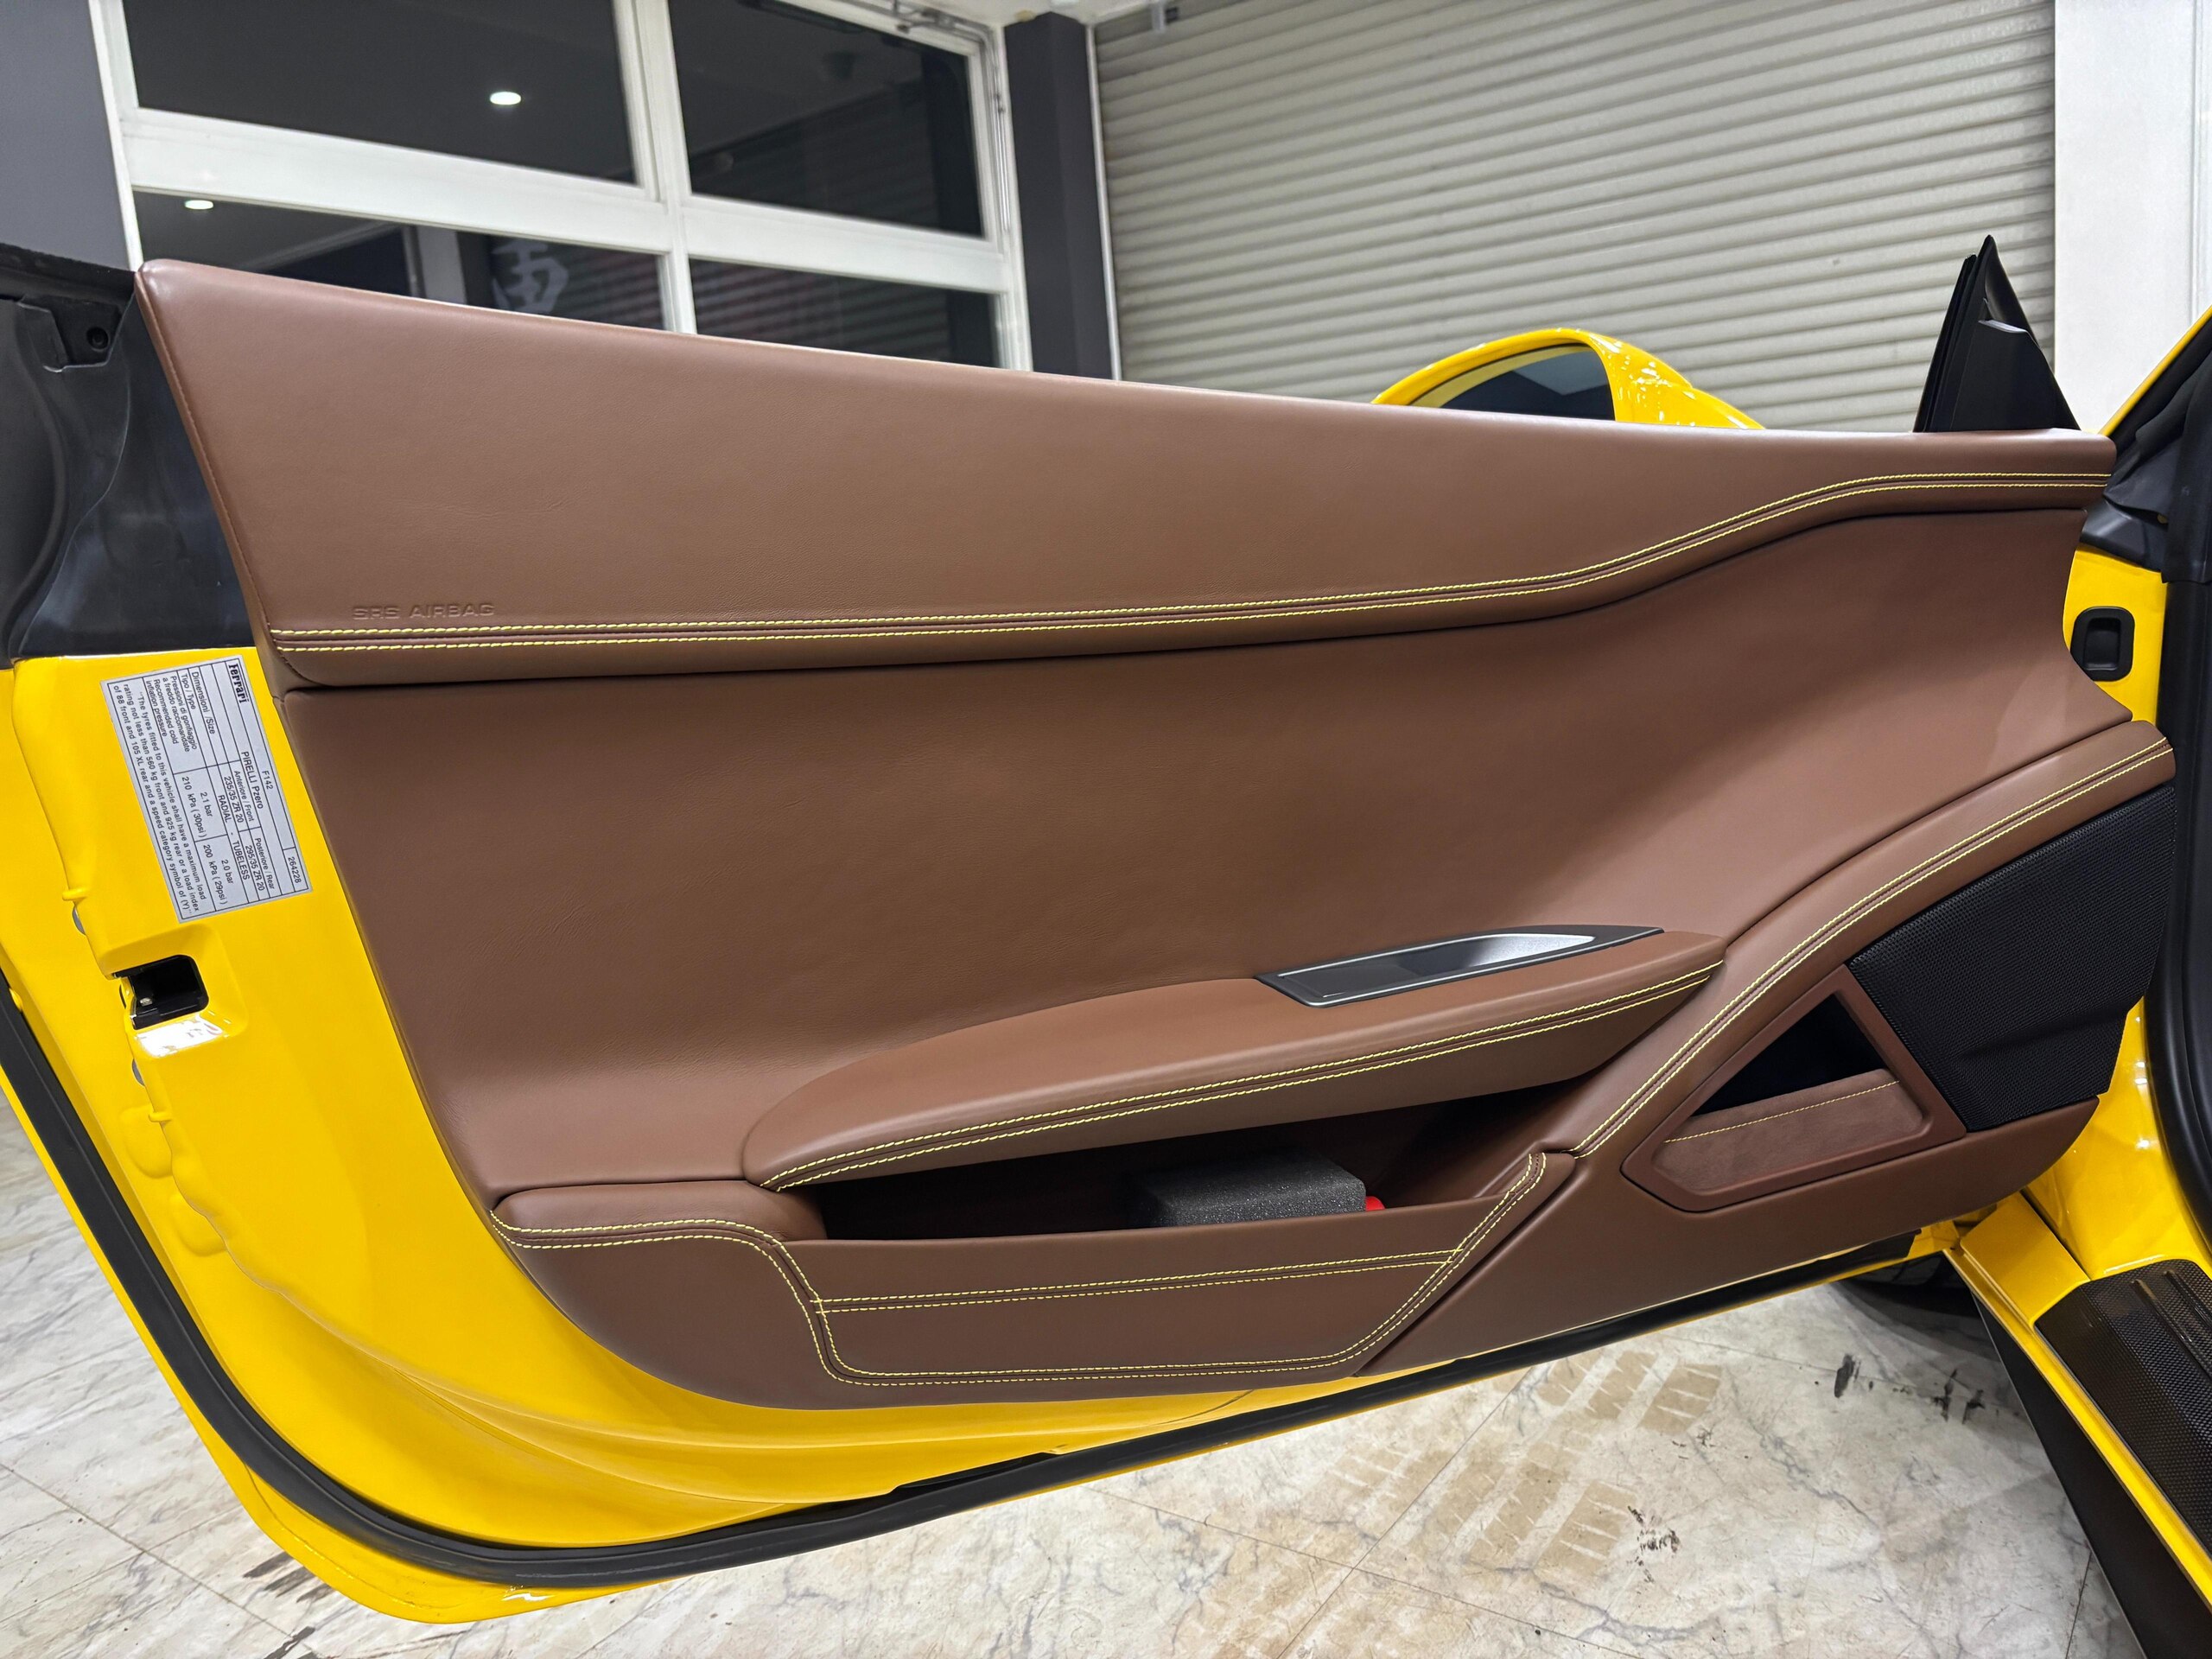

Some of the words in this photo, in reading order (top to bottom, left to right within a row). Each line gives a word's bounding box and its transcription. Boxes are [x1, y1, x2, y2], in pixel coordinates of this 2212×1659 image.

[352, 606, 400, 620] SRS
[408, 603, 495, 620] AIRBAG
[228, 664, 249, 703] Ferrari
[117, 695, 124, 704] 88
[124, 684, 134, 706] rating
[187, 694, 196, 709] Type
[120, 706, 130, 723] front
[130, 708, 140, 720] not
[154, 679, 175, 728] Recommended
[169, 730, 179, 744] cold
[164, 683, 175, 705] freddo
[172, 706, 190, 752] raccomandate
[170, 676, 185, 706] Pressioni
[181, 715, 197, 750] gonfiaggio
[135, 721, 144, 737] less
[153, 708, 168, 737] pressure
[126, 726, 137, 740] and
[131, 741, 141, 754] 105
[141, 738, 149, 754] than
[136, 756, 144, 766] XL
[146, 756, 156, 770] 560
[140, 768, 149, 782] rear
[150, 772, 158, 781] kg
[241, 752, 257, 783] PIRELLI
[251, 785, 264, 809] Pzero
[262, 771, 273, 790] F142
[145, 785, 155, 798] and
[155, 783, 165, 800] front
[182, 777, 192, 790] 210
[188, 793, 196, 808] kPa
[224, 776, 238, 801] 235/35
[234, 771, 247, 799] Anteriore
[245, 804, 254, 822] Front
[142, 712, 152, 730] tyres
[149, 732, 160, 751] fitted
[158, 762, 167, 776] this
[163, 778, 175, 803] vehicle
[171, 805, 182, 823] shall
[177, 823, 187, 841] have
[186, 849, 200, 883] maximum
[197, 884, 207, 899] load
[200, 792, 210, 803] 2.1
[161, 802, 170, 816] and
[232, 802, 241, 812] ZR
[152, 807, 164, 829] speed
[165, 817, 175, 830] 925
[235, 814, 245, 823] 20
[160, 830, 173, 861] category
[169, 832, 177, 842] kg
[218, 795, 232, 823] RADIAL
[232, 840, 250, 880] TUBELESS
[174, 843, 182, 856] rear
[245, 845, 258, 869] 295/35
[203, 844, 213, 858] 200
[209, 861, 218, 875] kPa
[221, 860, 231, 871] 2.0
[255, 838, 269, 870] Posteriore
[266, 874, 275, 889] Rear
[169, 863, 183, 888] symbol
[253, 870, 262, 880] ZR
[288, 856, 302, 883] 264228
[184, 874, 194, 890] load
[257, 882, 265, 891] 20
[189, 893, 199, 912] index
